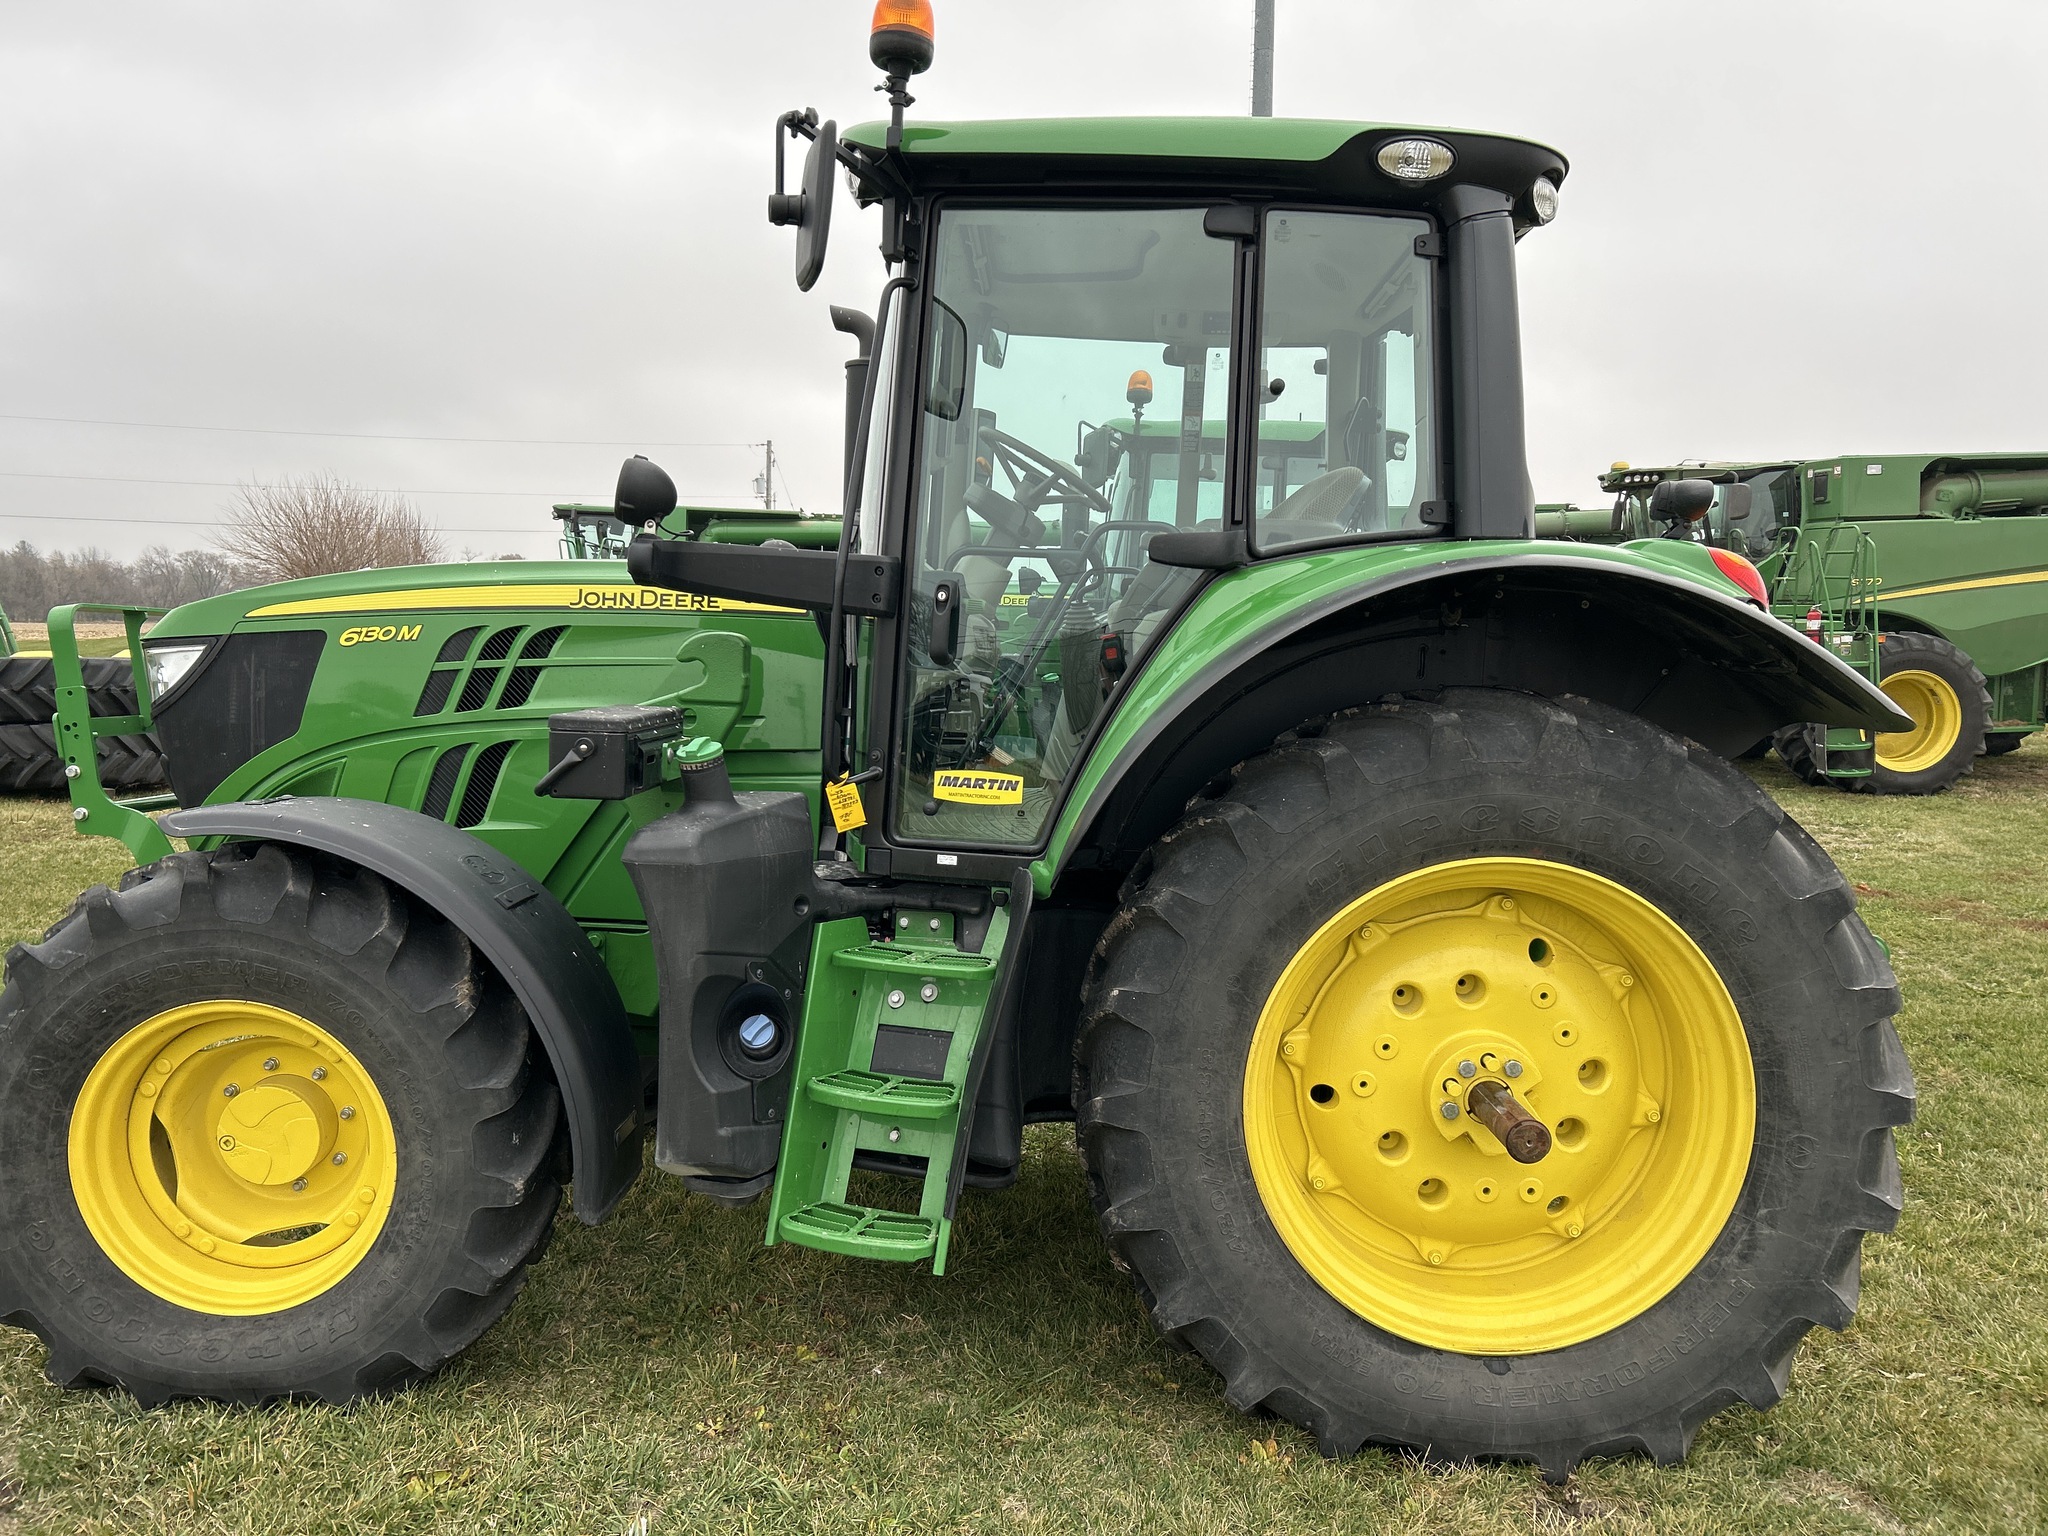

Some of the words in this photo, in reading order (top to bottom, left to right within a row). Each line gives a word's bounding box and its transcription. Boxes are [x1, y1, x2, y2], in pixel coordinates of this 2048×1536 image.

[569, 588, 635, 607] JOHN
[640, 589, 720, 609] DEERE
[941, 775, 1020, 791] MARTIN
[1472, 1278, 1758, 1409] PERFORMER
